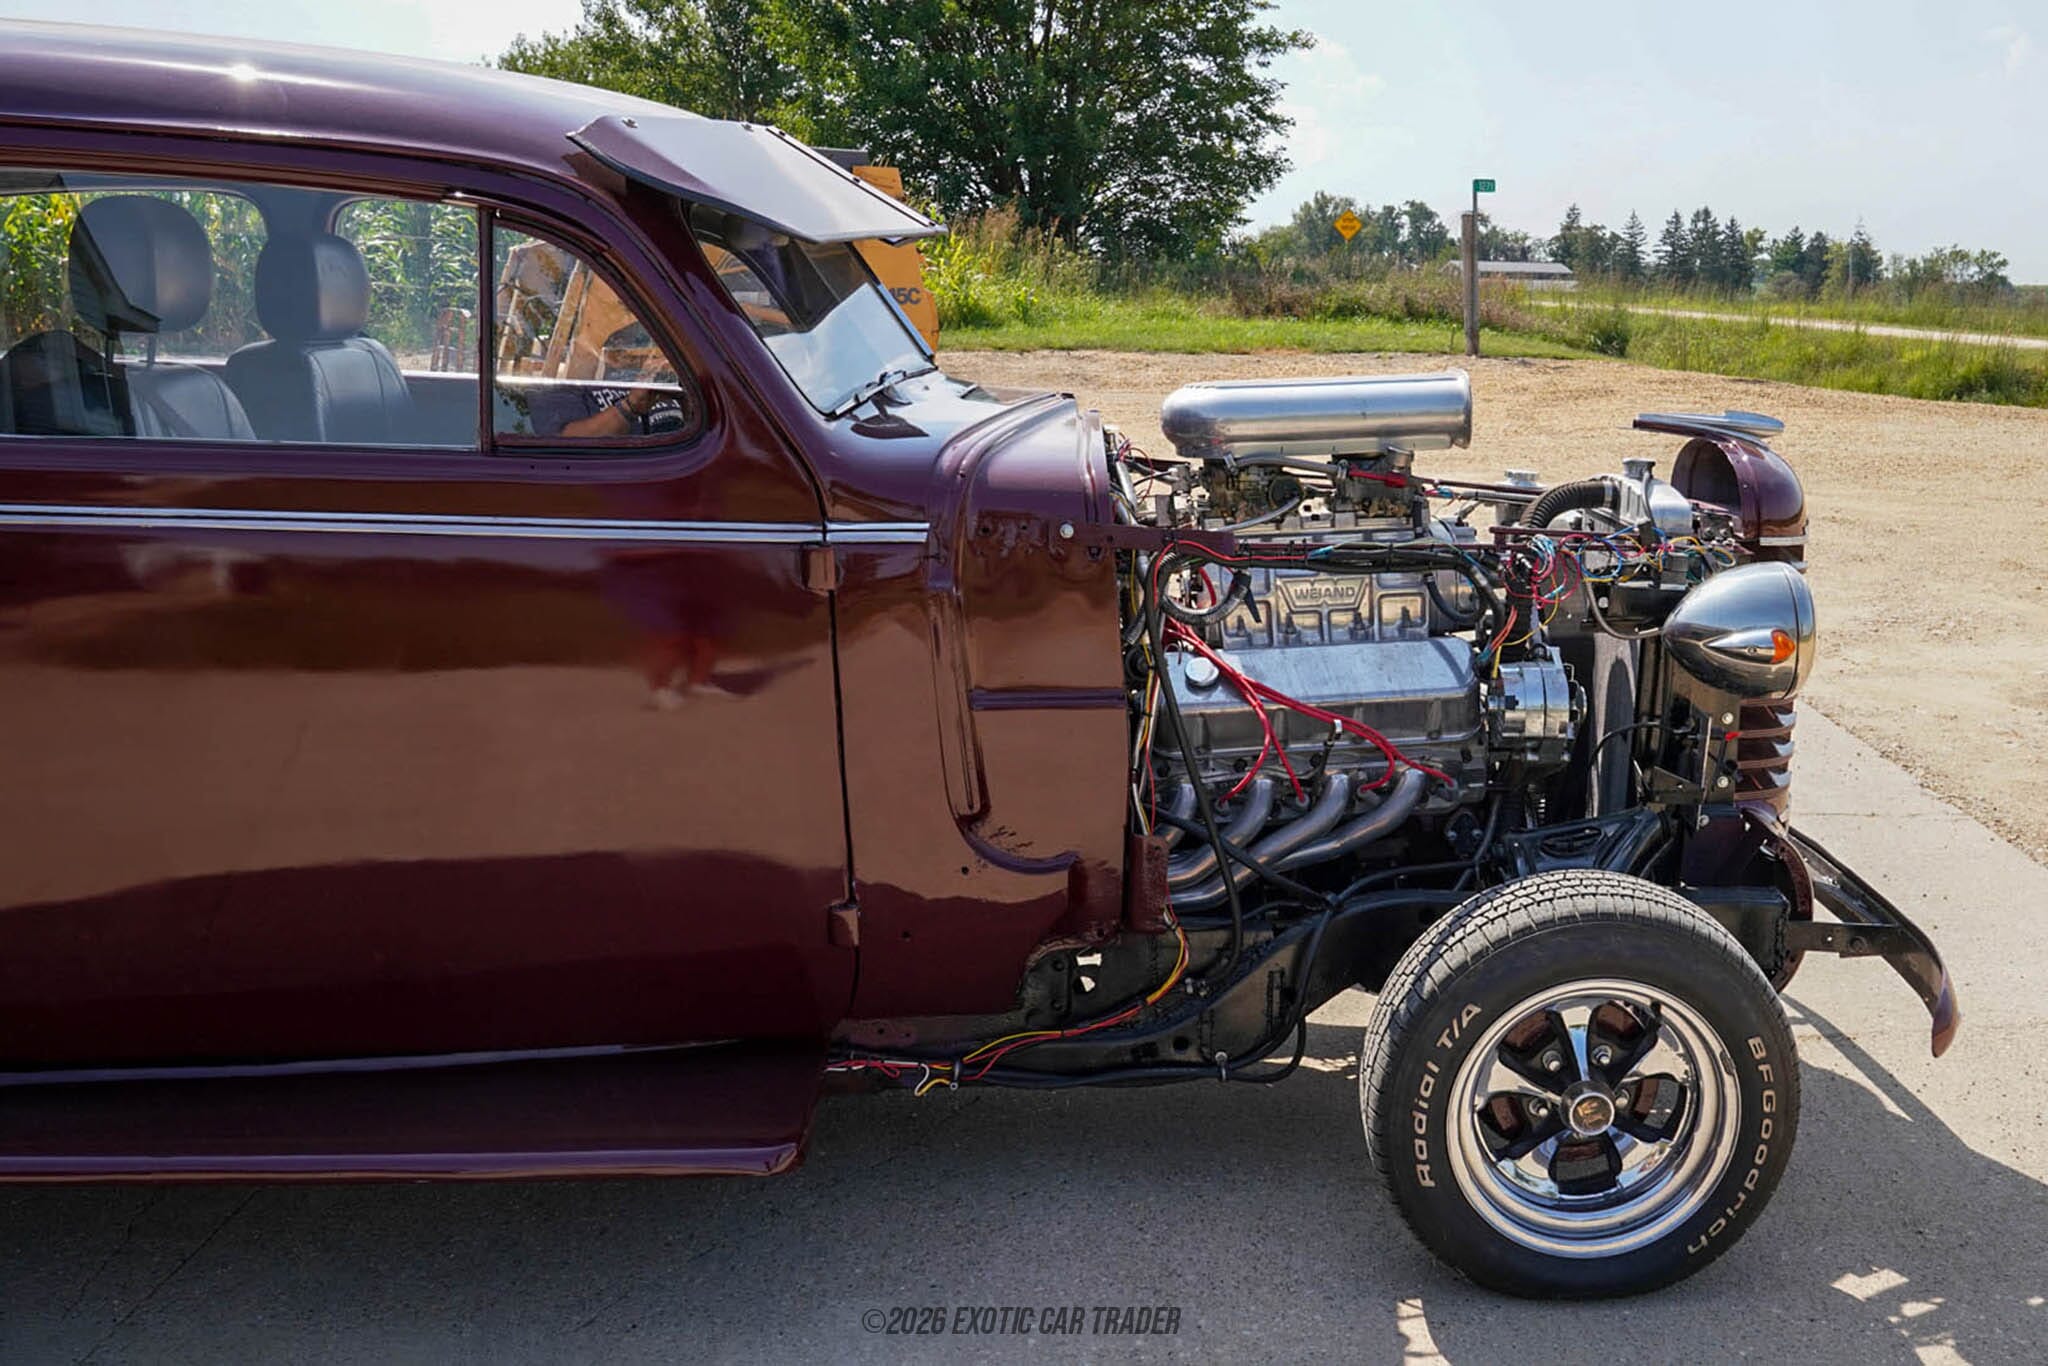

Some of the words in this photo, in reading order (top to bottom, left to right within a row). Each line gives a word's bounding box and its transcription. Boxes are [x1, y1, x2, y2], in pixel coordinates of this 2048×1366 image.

[1294, 585, 1356, 600] WEIAND
[1411, 1061, 1441, 1189] Radial
[1437, 1002, 1482, 1050] T/A
[1687, 1036, 1777, 1256] BFGoodrich
